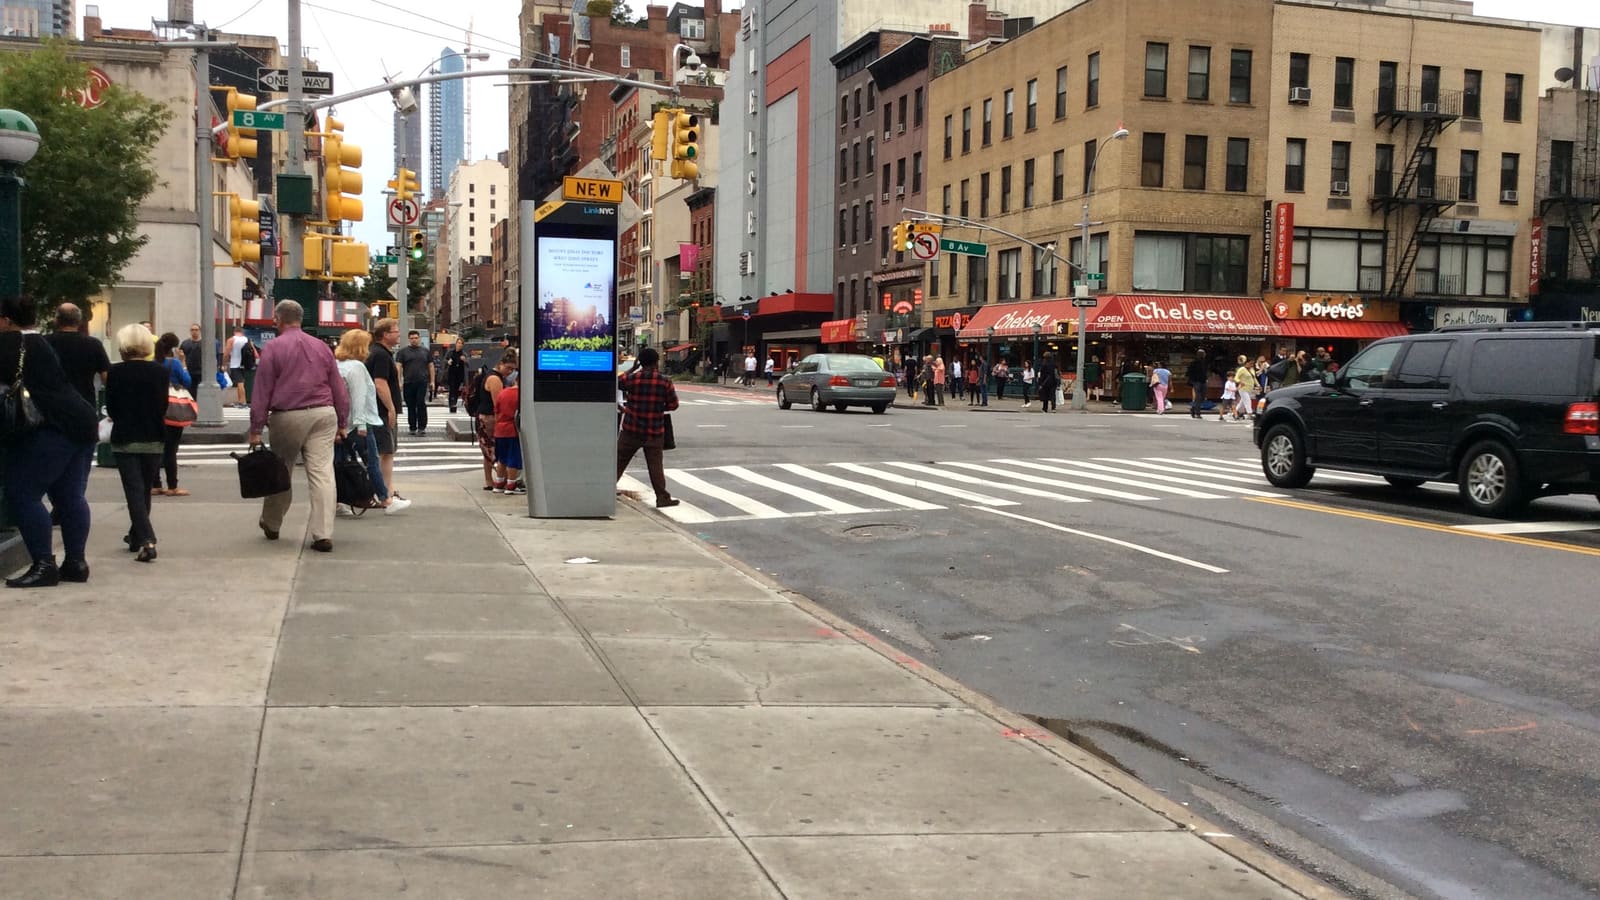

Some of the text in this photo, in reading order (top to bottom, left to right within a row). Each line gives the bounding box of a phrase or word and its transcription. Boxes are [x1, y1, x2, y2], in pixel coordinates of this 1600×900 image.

[266, 75, 326, 88] ONE WAY
[243, 113, 254, 126] 8
[576, 182, 610, 197] NEW
[583, 207, 615, 215] LinkNYC
[1531, 238, 1540, 275] WATCH
[1134, 302, 1236, 321] Chelsea
[993, 309, 1051, 330] Chelsea
[1097, 315, 1124, 323] OPEN
[1236, 323, 1268, 331] Bakery
